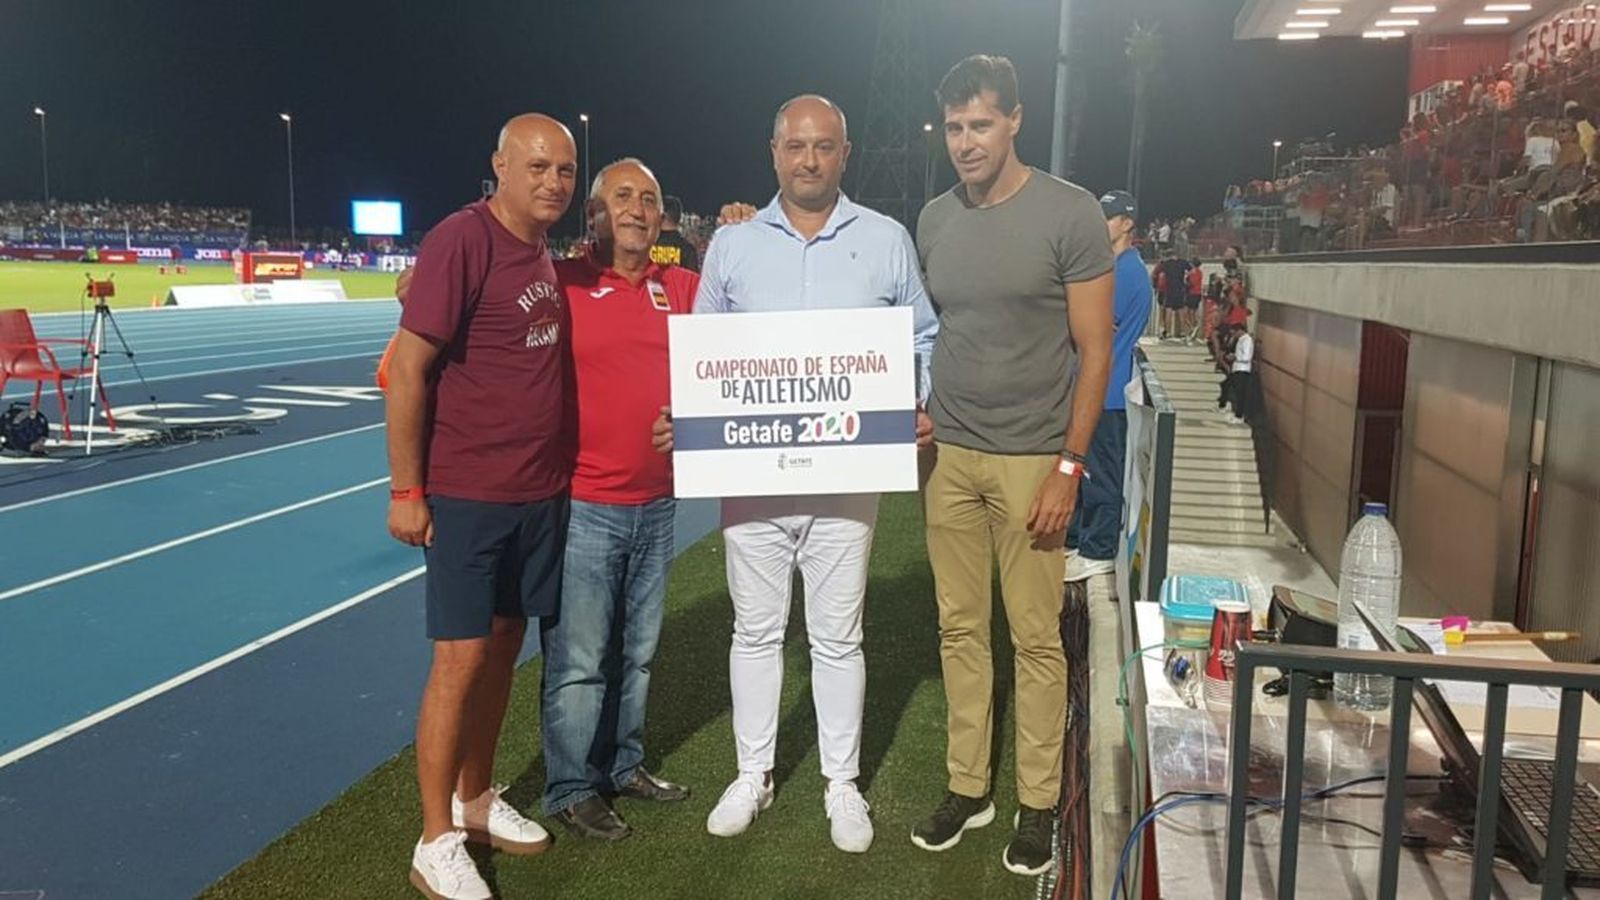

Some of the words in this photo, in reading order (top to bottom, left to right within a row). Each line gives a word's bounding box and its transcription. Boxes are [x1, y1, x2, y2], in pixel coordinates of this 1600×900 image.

[696, 359, 798, 380] CAMPEONATO
[805, 356, 824, 376] DE
[830, 350, 888, 374] ESPAÑA
[721, 379, 740, 399] DE
[741, 375, 851, 405] ATLETISMO
[724, 420, 793, 444] Getafe
[798, 411, 860, 442] 2020
